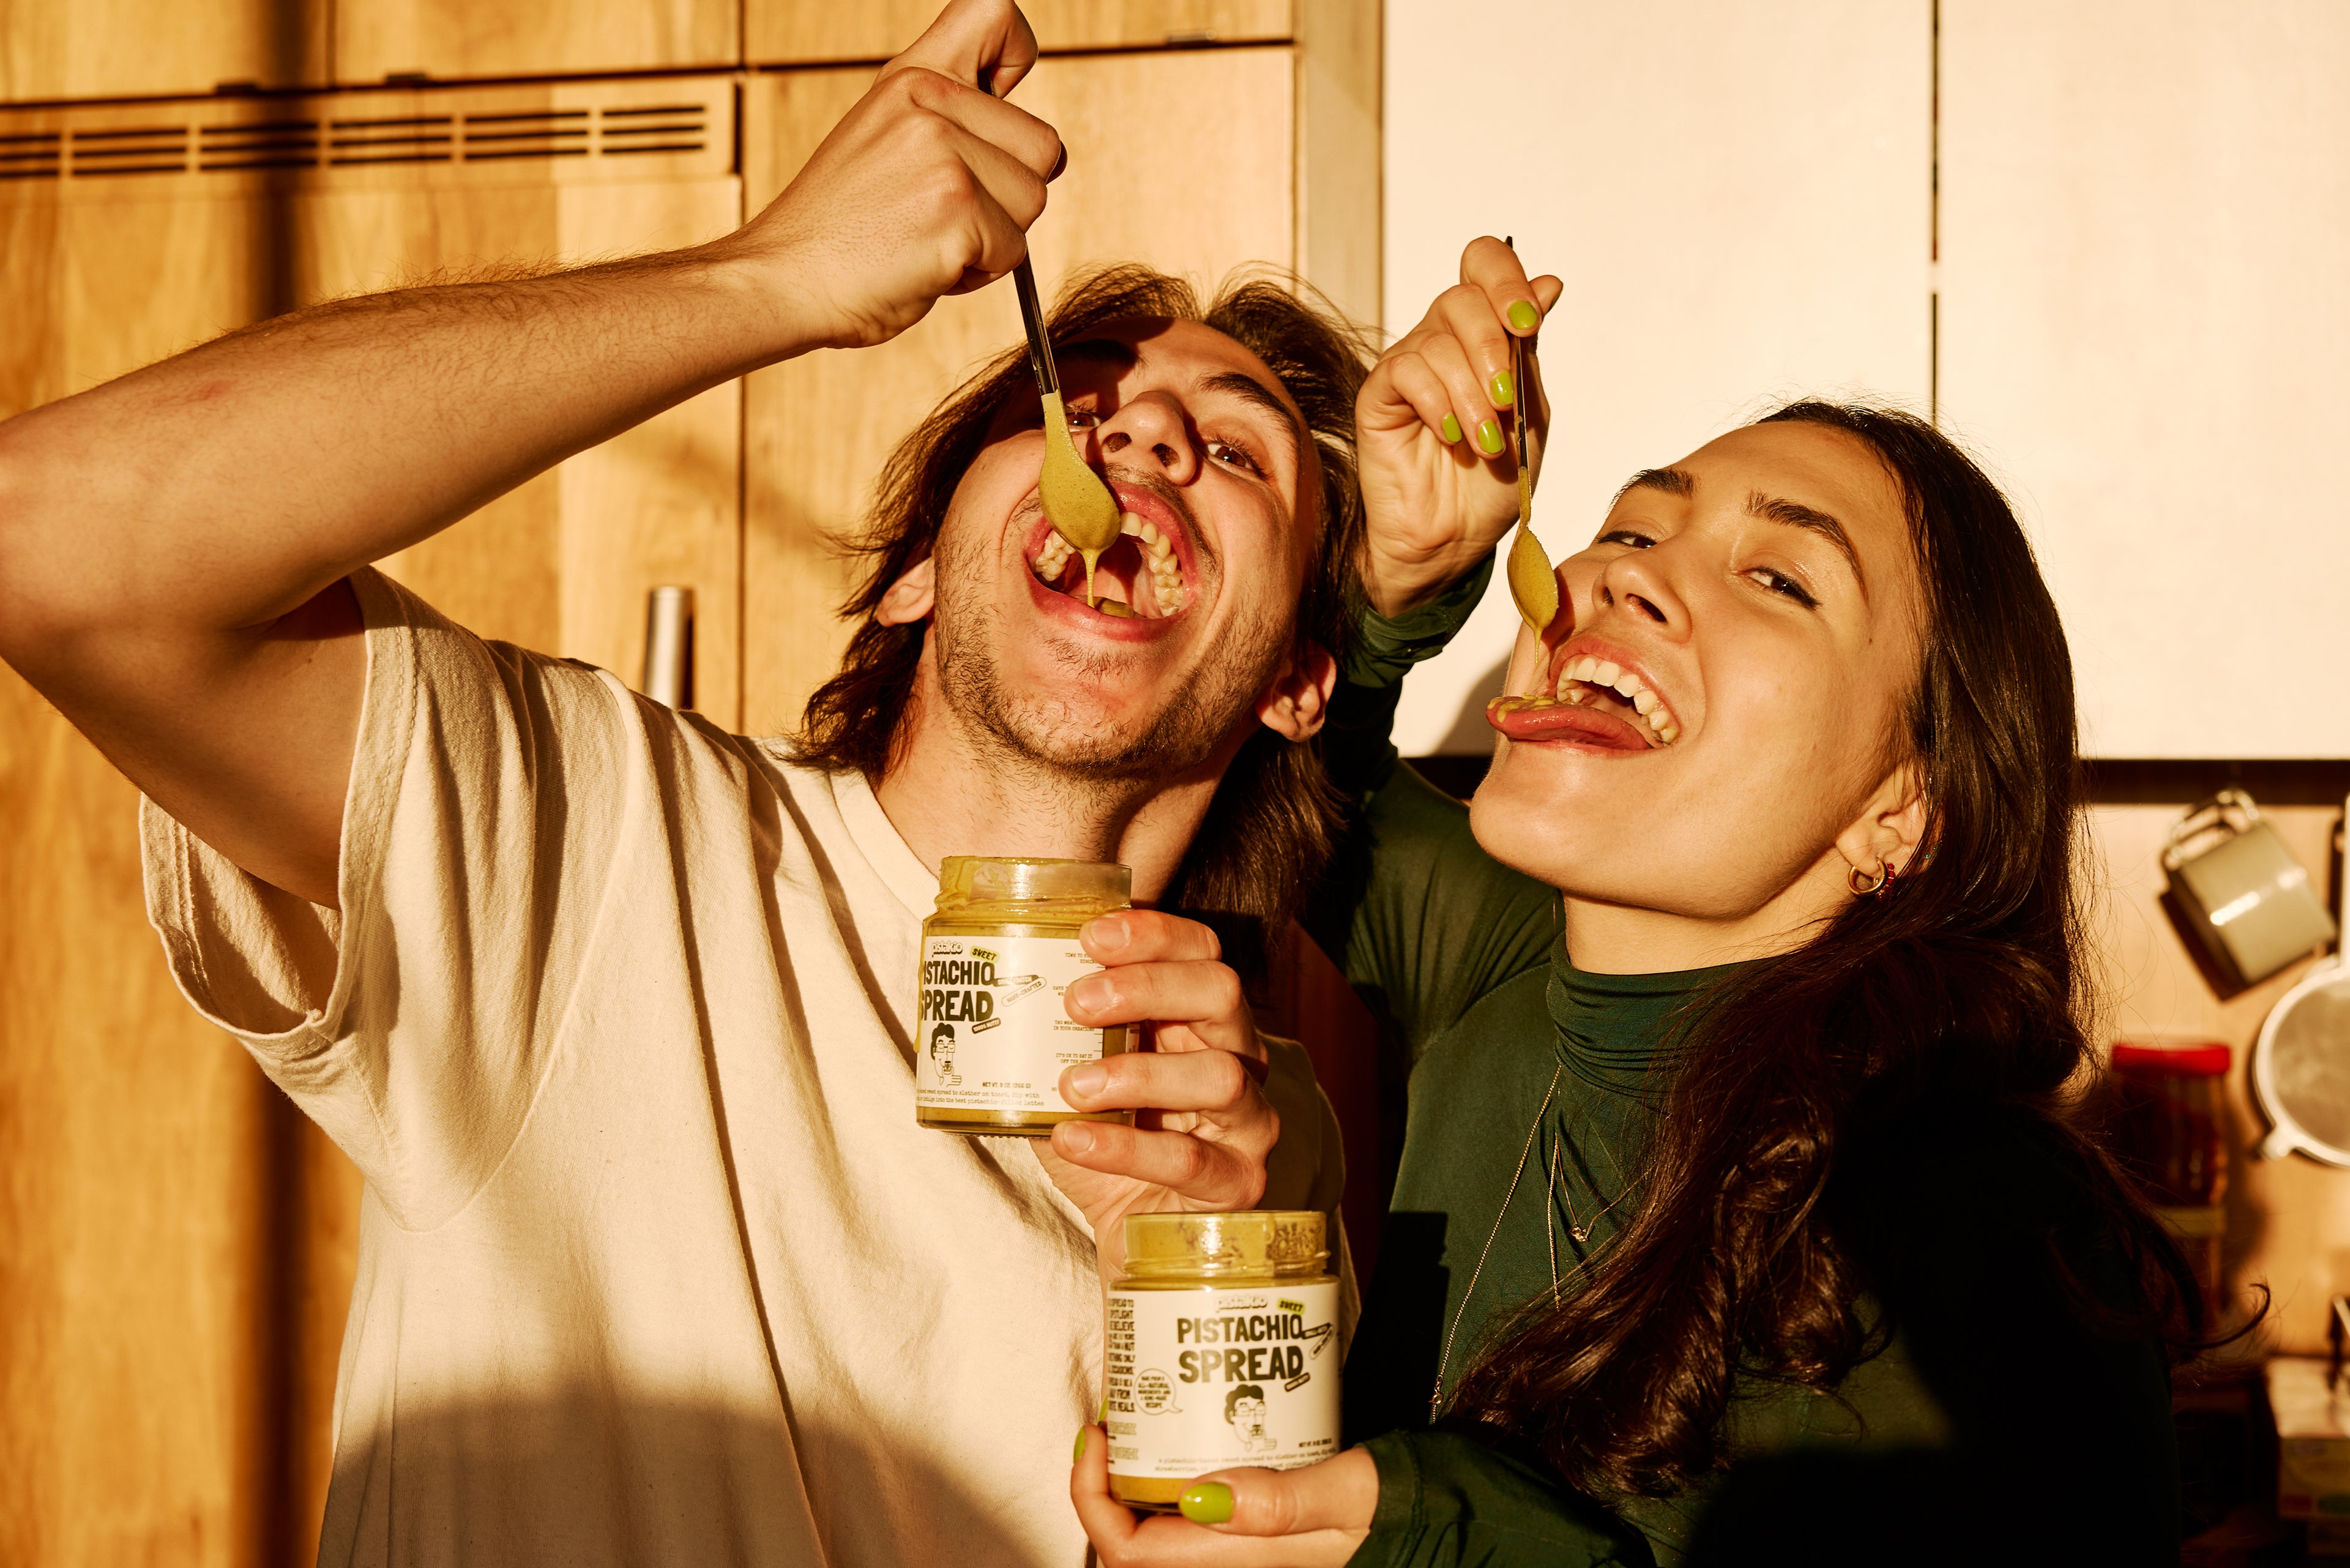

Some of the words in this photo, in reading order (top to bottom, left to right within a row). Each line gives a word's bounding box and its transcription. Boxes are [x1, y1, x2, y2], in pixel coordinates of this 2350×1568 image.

[972, 948, 998, 961] SWEET
[1279, 1300, 1304, 1312] SWEET
[1177, 1314, 1302, 1343] PISTACHIO
[1179, 1346, 1303, 1383] SPREAD
